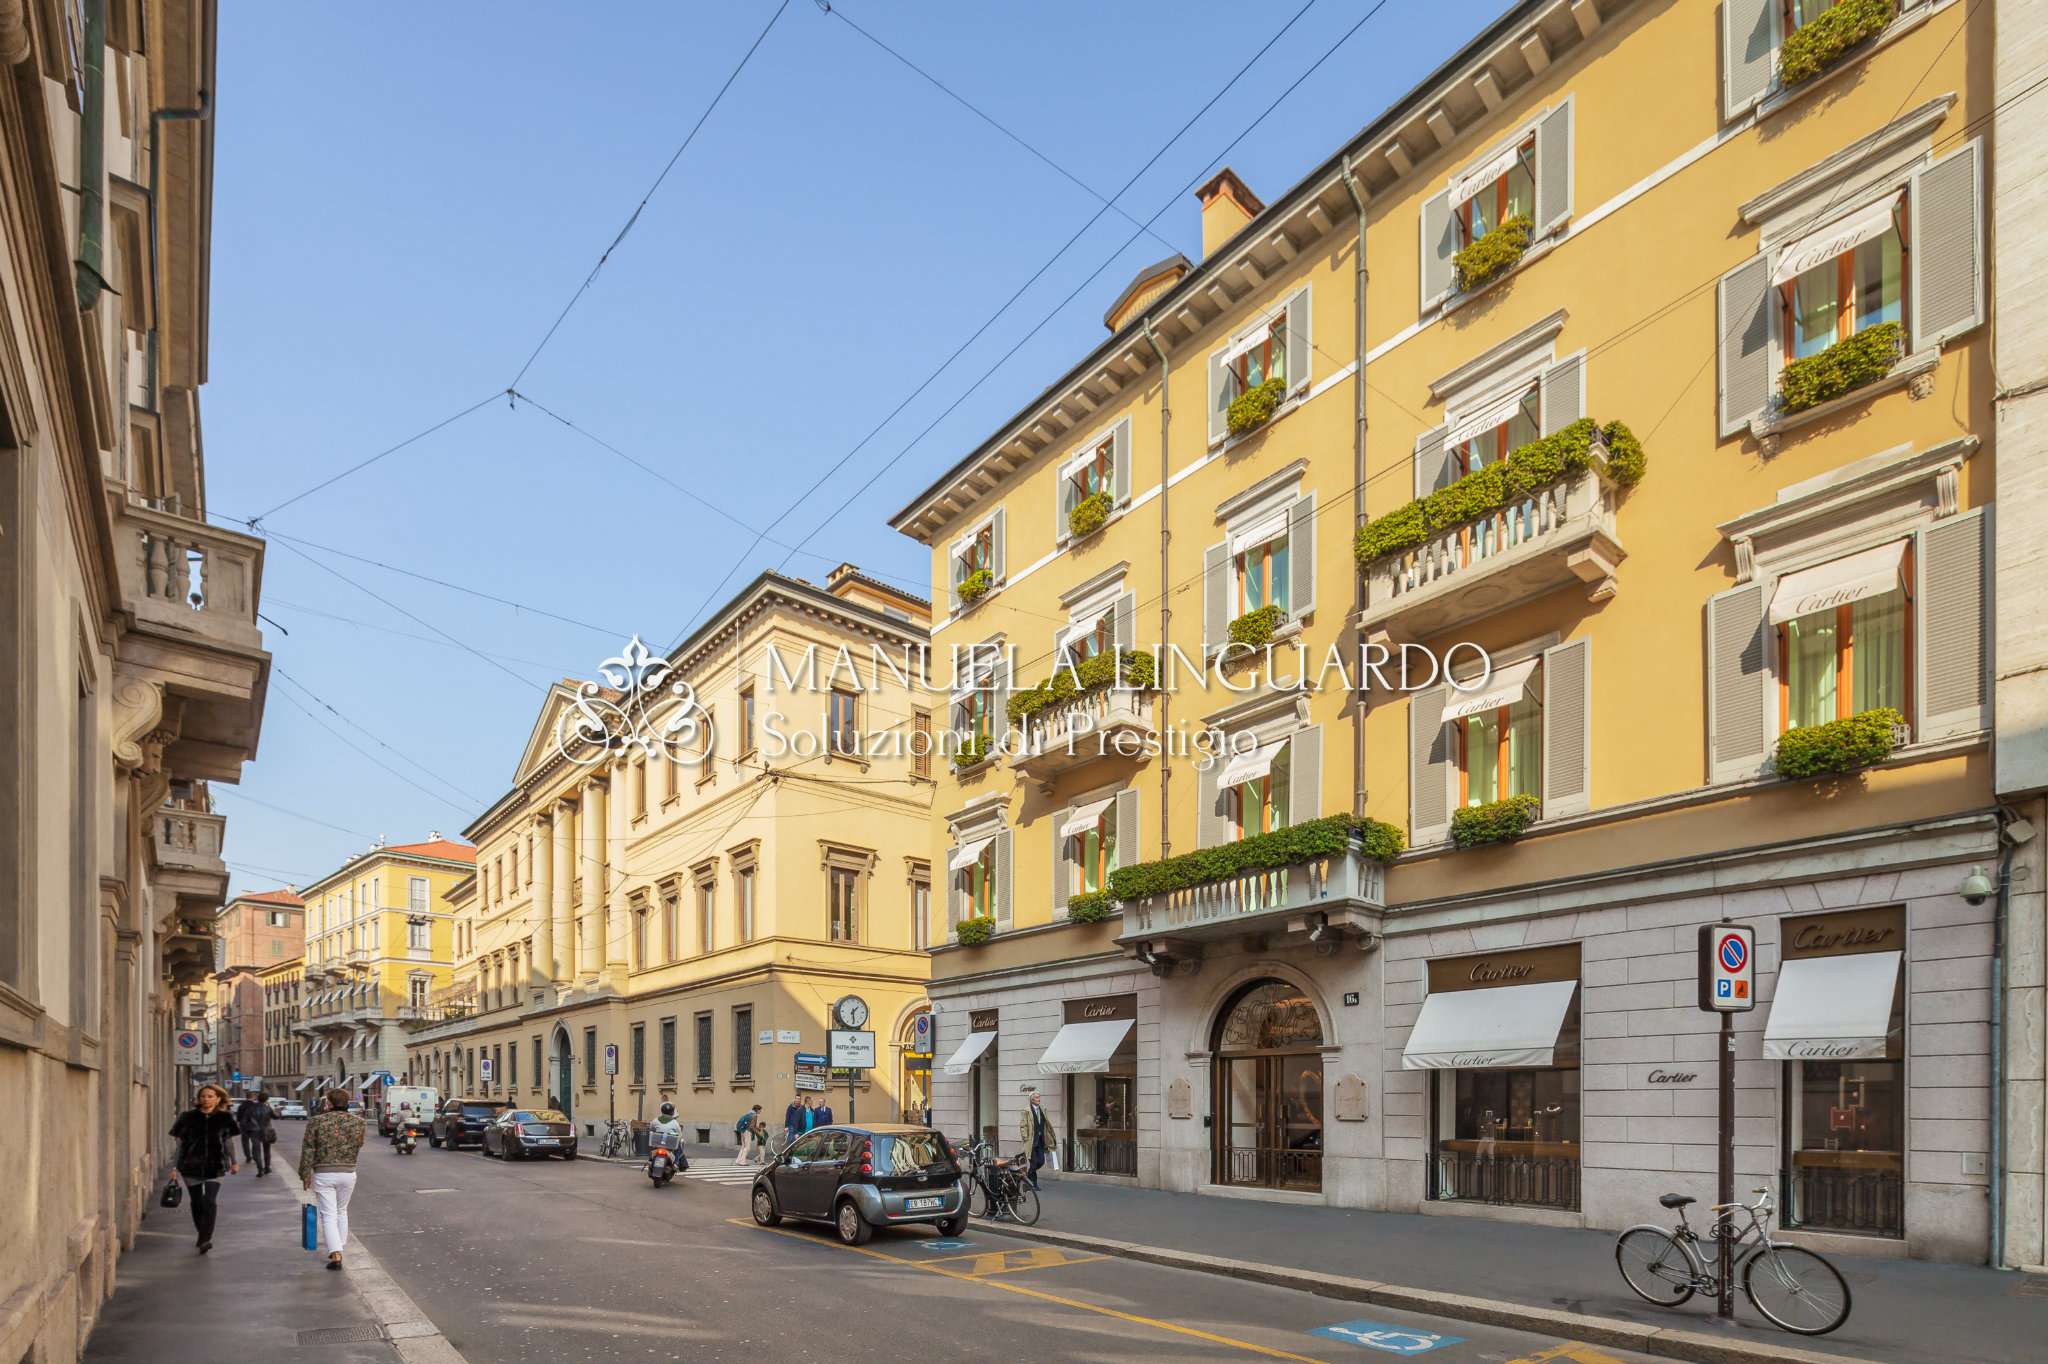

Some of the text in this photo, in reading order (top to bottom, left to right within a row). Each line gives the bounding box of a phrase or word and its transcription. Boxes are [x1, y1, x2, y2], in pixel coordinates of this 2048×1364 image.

[1795, 229, 1867, 272] Cartier
[1796, 586, 1868, 614] Cartier
[1457, 696, 1505, 715] Cartier
[1227, 770, 1257, 785] Cartier
[1793, 924, 1896, 950] Cartier
[1469, 960, 1535, 982] Cartier
[1084, 1003, 1117, 1018] Cartier
[973, 1015, 998, 1029] Cartier
[1788, 1040, 1859, 1057] Cartier
[1451, 1054, 1497, 1065] Cartier
[1648, 1069, 1698, 1084] Cartier
